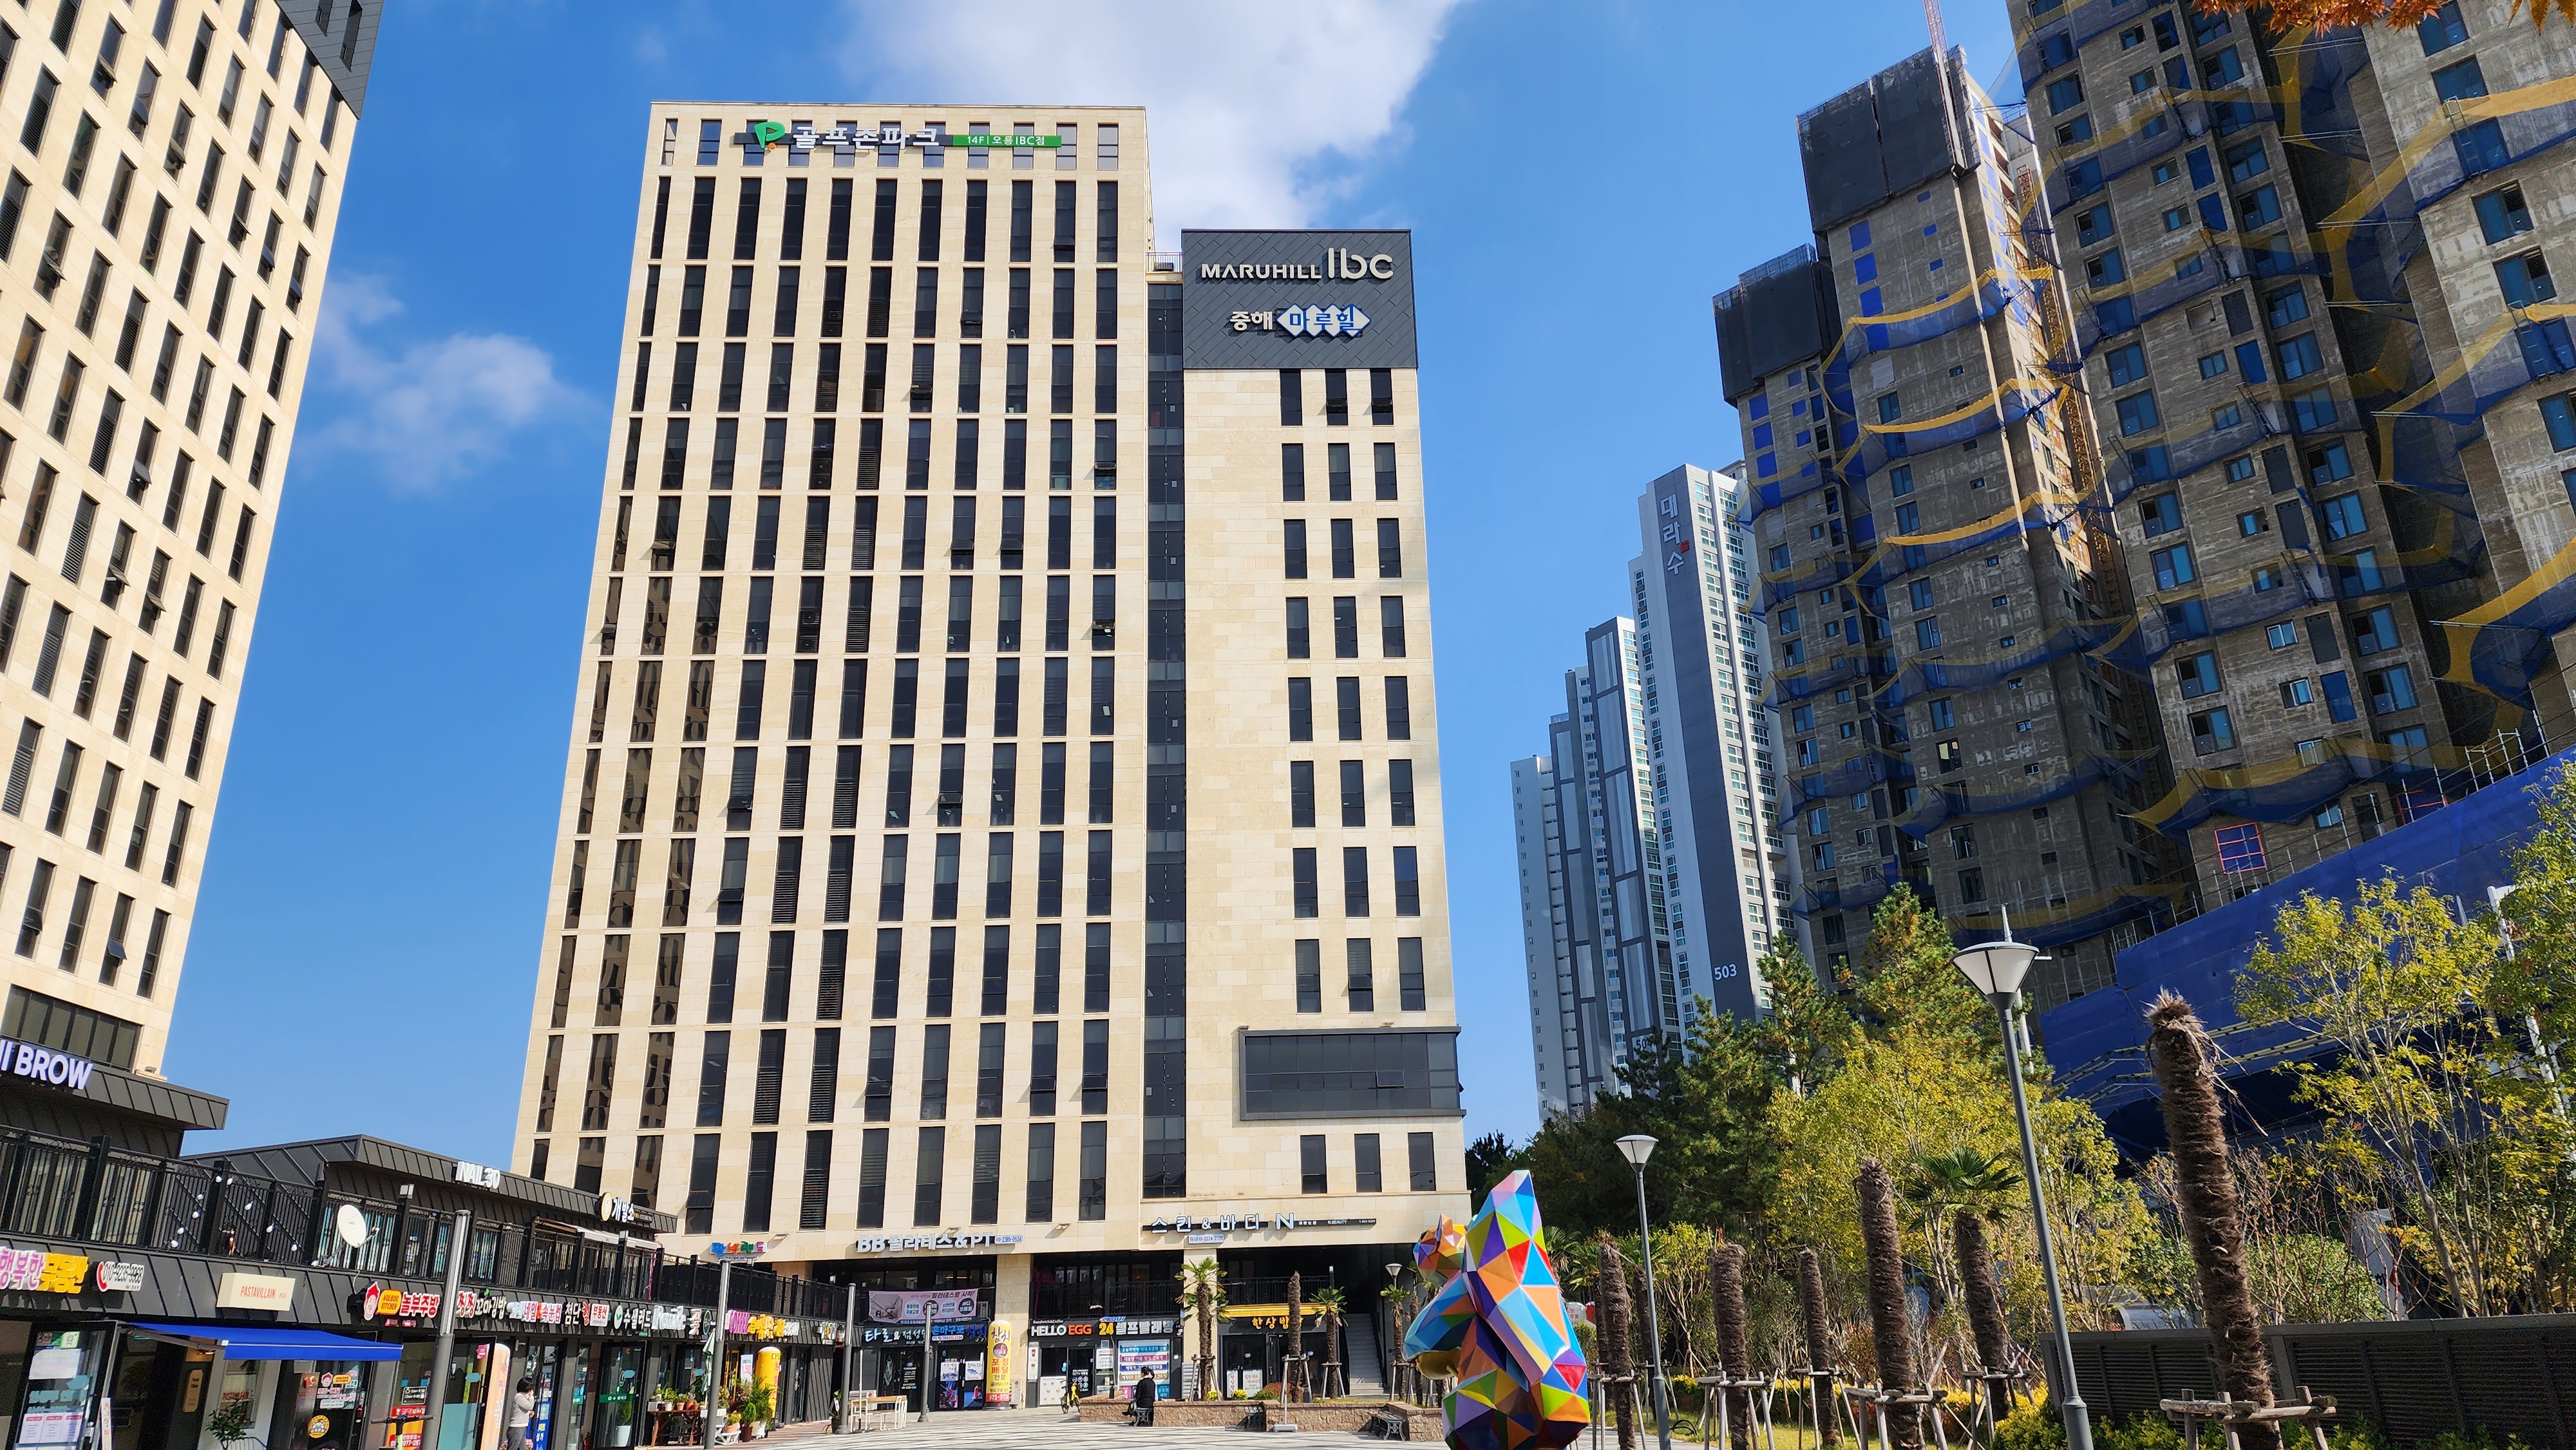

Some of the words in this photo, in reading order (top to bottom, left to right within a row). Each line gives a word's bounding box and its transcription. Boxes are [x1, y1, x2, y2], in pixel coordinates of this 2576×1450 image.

[793, 126, 940, 151] 골프존파크
[967, 136, 985, 144] 14F
[1201, 263, 1322, 279] MARUHILL
[1229, 310, 1273, 332] 중해
[1289, 305, 1365, 333] 마루힐
[1660, 493, 1685, 575] 대라수
[1714, 963, 1738, 981] 503
[14, 1044, 93, 1090] BROW
[455, 1161, 485, 1186] NAIL
[611, 1196, 634, 1223] 개발소
[1151, 1216, 1191, 1234] 스킨
[1202, 1217, 1212, 1230] &
[1220, 1214, 1260, 1232] 바디
[1275, 1212, 1295, 1230] N
[857, 1235, 886, 1253] BB
[888, 1232, 953, 1251] 필라테스
[240, 1286, 276, 1299] PASTAVILLAIN
[399, 1292, 440, 1318] 놀부주방
[623, 1308, 652, 1330] 수샐러드
[932, 1324, 965, 1335] 혼마구로
[1099, 1322, 1113, 1335] 24
[1115, 1321, 1174, 1335] 셀프빨래방
[864, 1328, 893, 1342] 타로
[1031, 1324, 1067, 1337] HELLO
[1068, 1324, 1092, 1335] EGG
